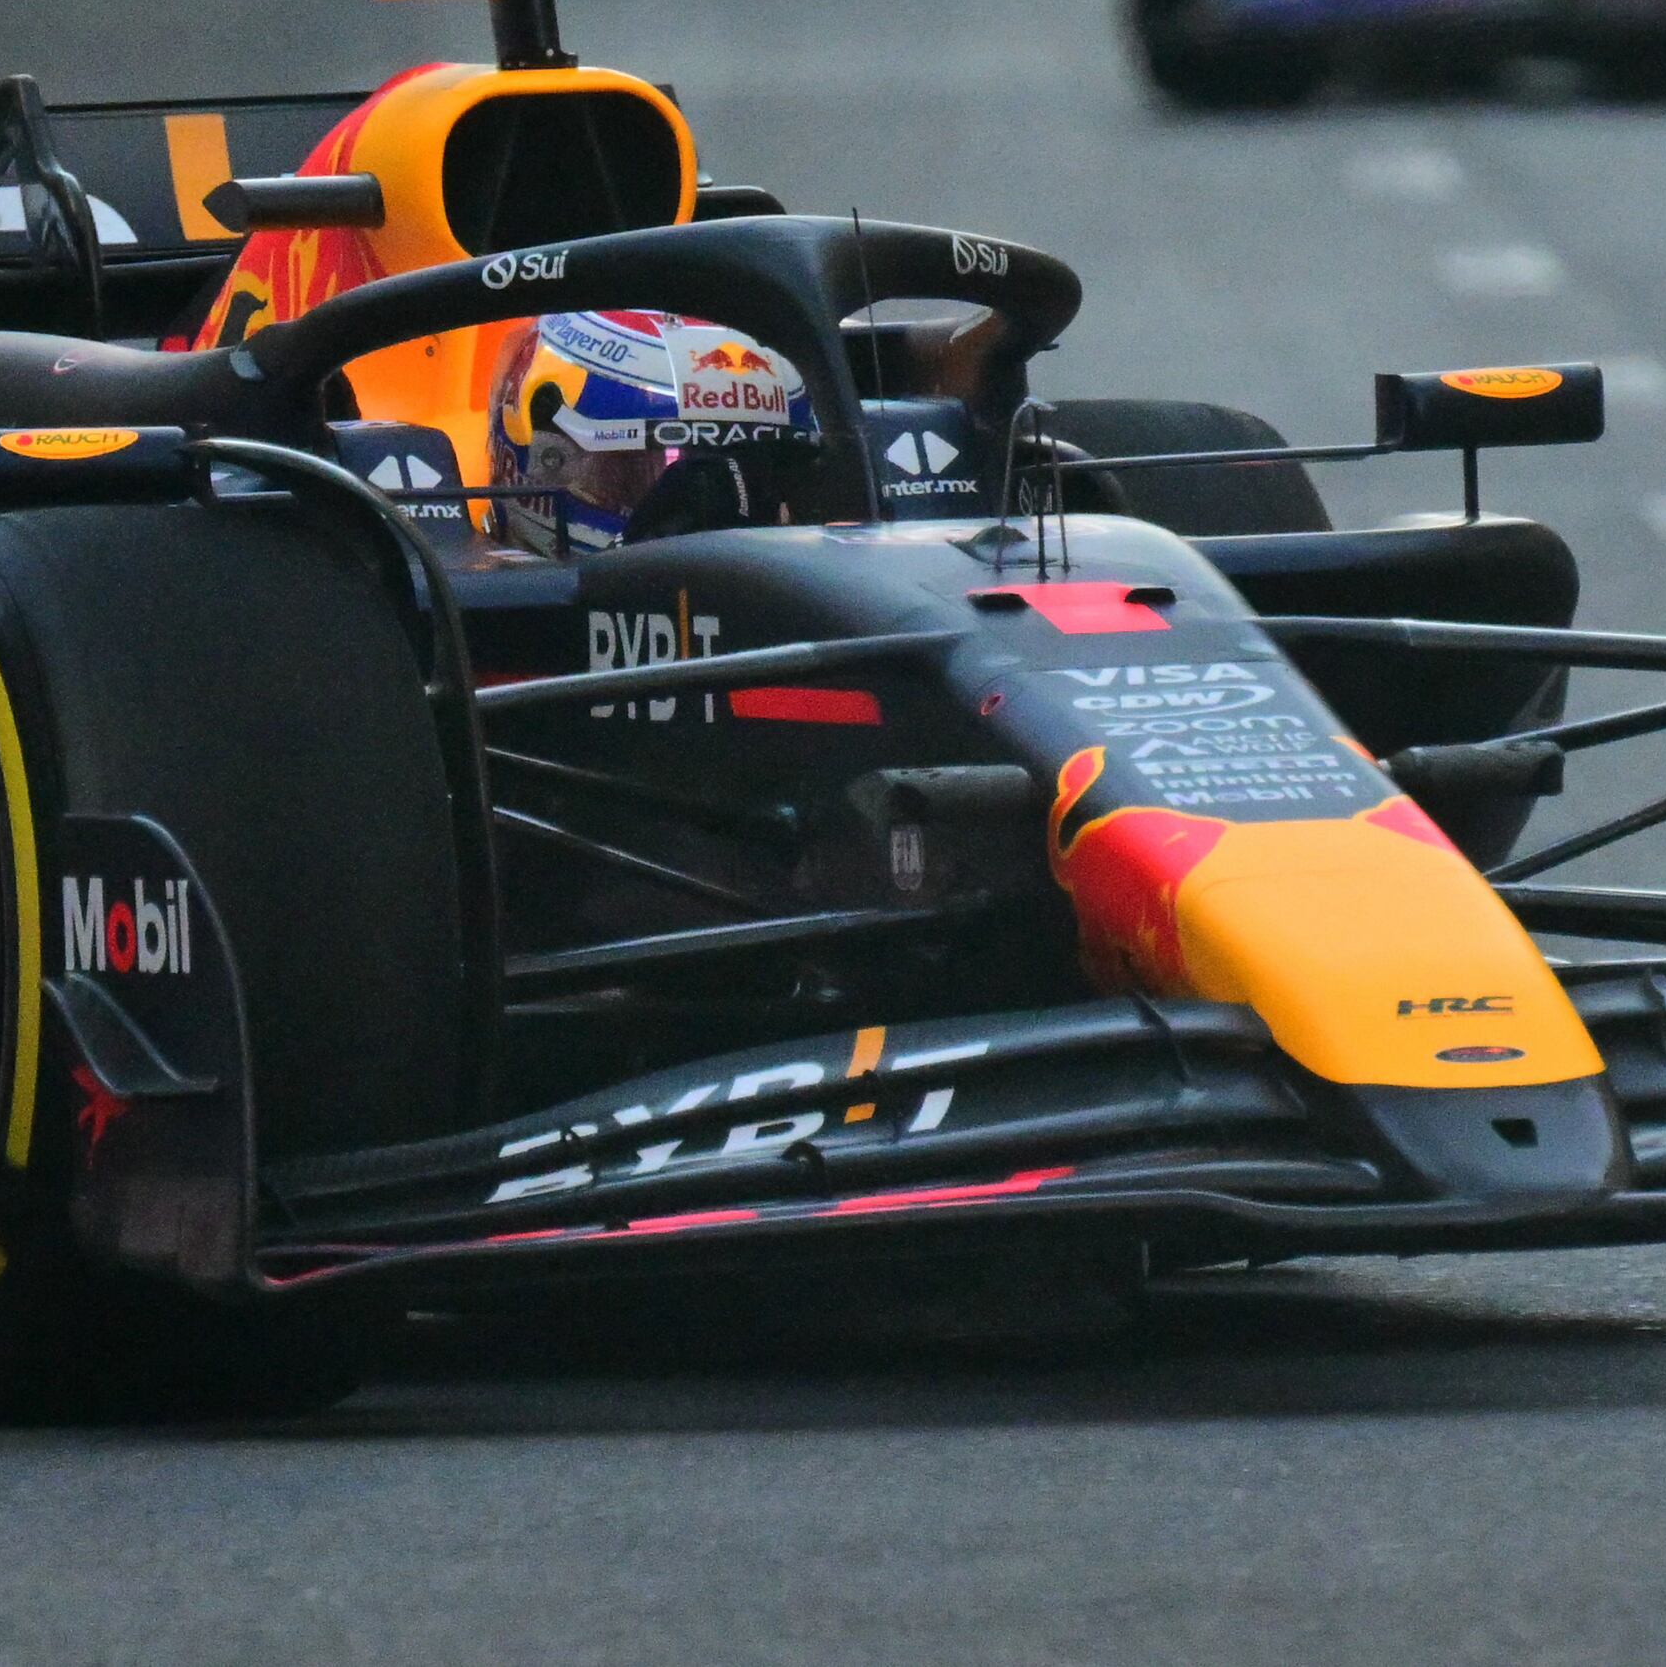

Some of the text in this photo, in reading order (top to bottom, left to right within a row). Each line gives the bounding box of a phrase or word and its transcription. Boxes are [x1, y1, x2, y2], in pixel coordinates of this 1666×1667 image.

[519, 249, 569, 280] Sui
[976, 243, 1009, 276] Sui
[1473, 373, 1548, 384] RAUCH
[683, 382, 787, 414] Red Bull
[37, 433, 119, 445] RAUCH
[595, 429, 625, 440] Mobil
[1047, 662, 1257, 687] VISA
[1072, 691, 1226, 710] CDW
[1193, 731, 1317, 746] ARCTIC
[1211, 740, 1309, 755] WOLF
[1163, 785, 1313, 807] Mobil
[63, 875, 190, 974] Mobil
[1396, 995, 1515, 1017] HRC
